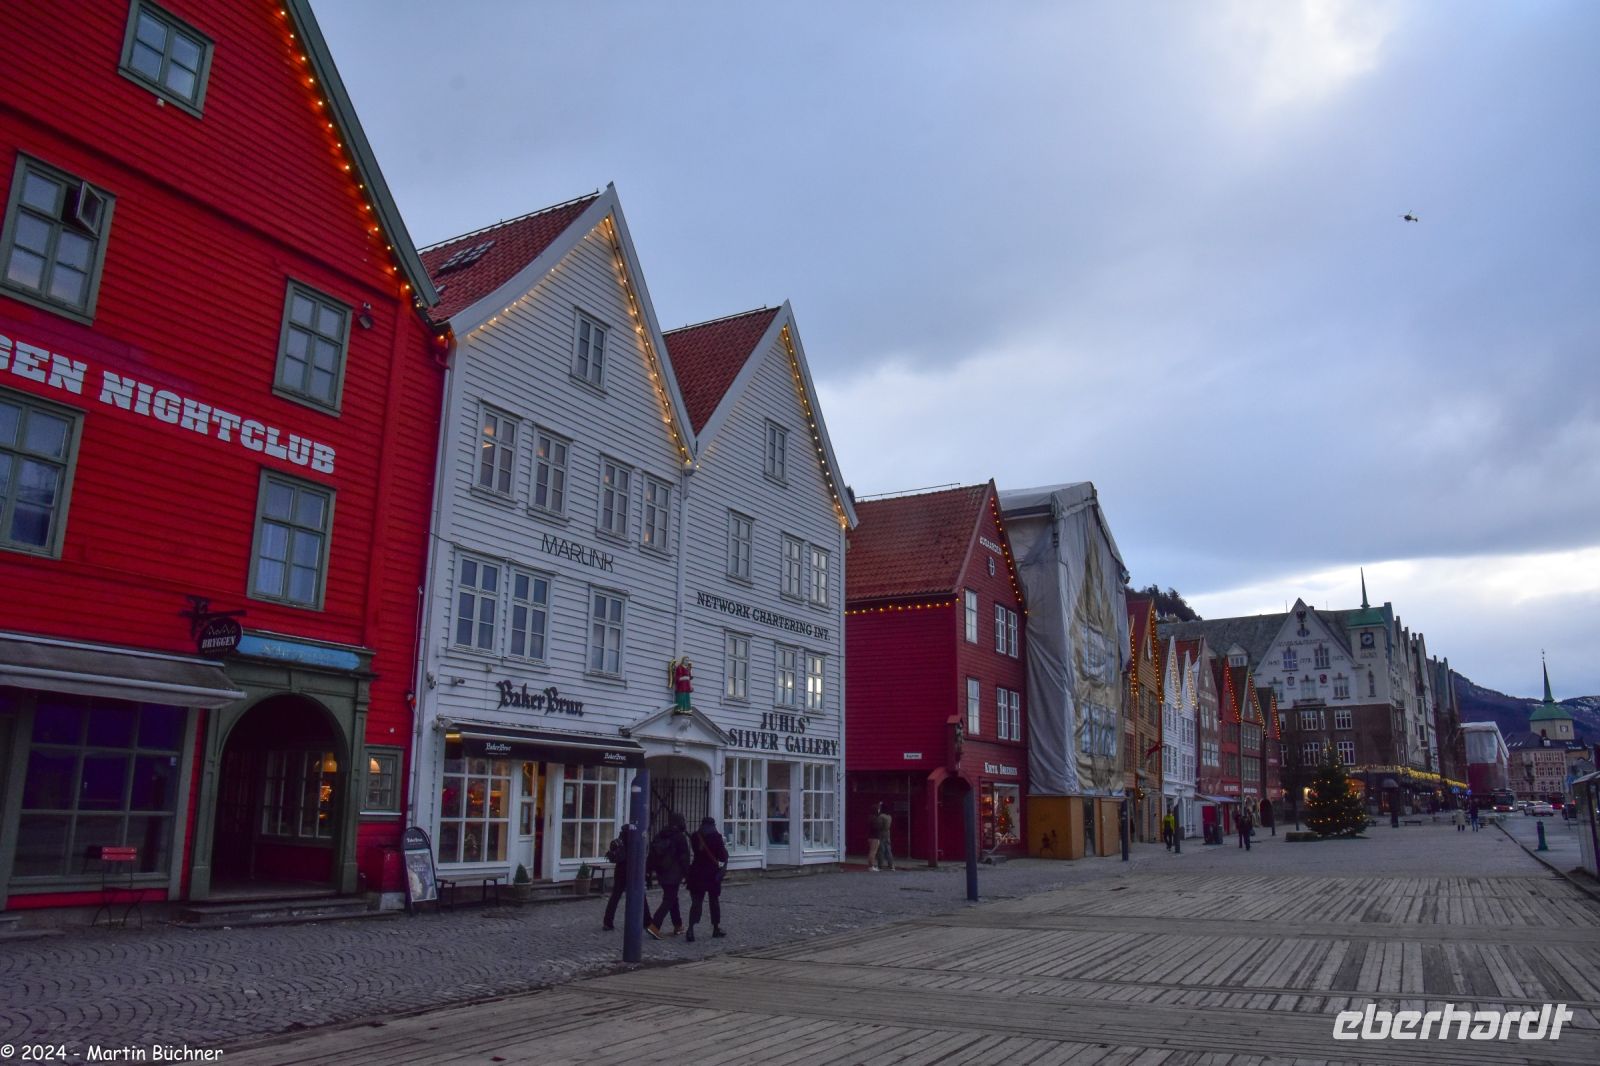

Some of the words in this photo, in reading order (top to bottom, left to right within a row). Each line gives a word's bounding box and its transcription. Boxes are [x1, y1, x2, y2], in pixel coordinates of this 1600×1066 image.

[99, 370, 336, 475] NIGHTCLUB
[541, 533, 614, 573] MARLINK
[696, 591, 750, 619] NETWORK
[752, 608, 812, 636] CHARTERING
[814, 626, 831, 641] INT.
[201, 635, 237, 650] BRYGGEN
[729, 727, 779, 751] SILVER
[785, 734, 838, 757] GALLERY
